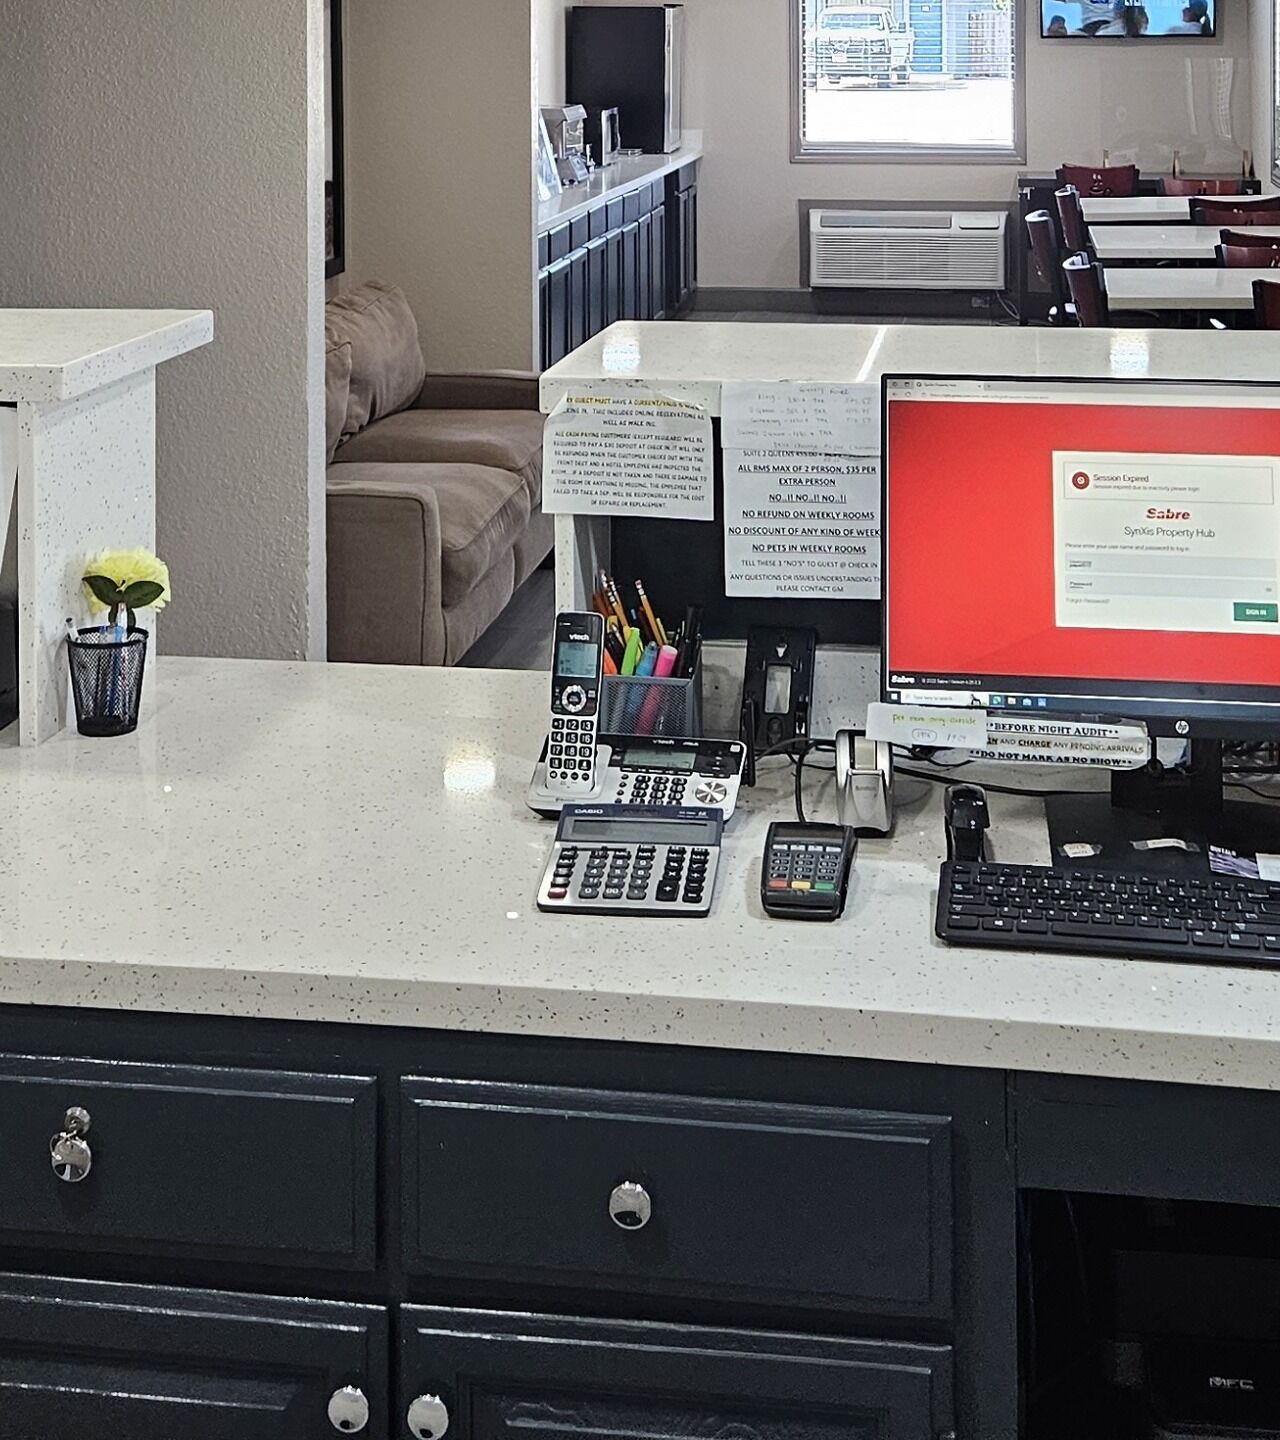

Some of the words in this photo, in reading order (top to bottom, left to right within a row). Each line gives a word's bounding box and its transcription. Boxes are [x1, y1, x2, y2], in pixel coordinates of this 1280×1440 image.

[737, 464, 751, 472] ALL
[753, 464, 770, 472] RMS
[805, 478, 835, 486] PERSON
[1092, 473, 1121, 482] Session
[1122, 474, 1149, 483] Expired
[742, 510, 755, 518] NO
[757, 510, 790, 518] REFUND
[792, 510, 805, 518] ON
[807, 511, 841, 519] WEEKLY
[842, 511, 874, 519] ROOMS
[1145, 507, 1190, 520] Sabre
[728, 526, 741, 534] NO
[743, 527, 785, 535] DISCOUNT
[787, 527, 799, 535] OF
[800, 527, 818, 535] ANY
[820, 528, 841, 536] KIND
[842, 528, 854, 536] OF
[1123, 526, 1154, 537] SynXis
[1155, 526, 1194, 539] Property
[1195, 528, 1215, 538] Hub
[751, 543, 765, 551] NO
[766, 543, 786, 552] PETS
[788, 544, 797, 552] IN
[799, 544, 832, 552] WEEKLY
[834, 545, 866, 553] ROOMS
[568, 633, 589, 641] vtech
[1208, 1375, 1255, 1391] MFC
